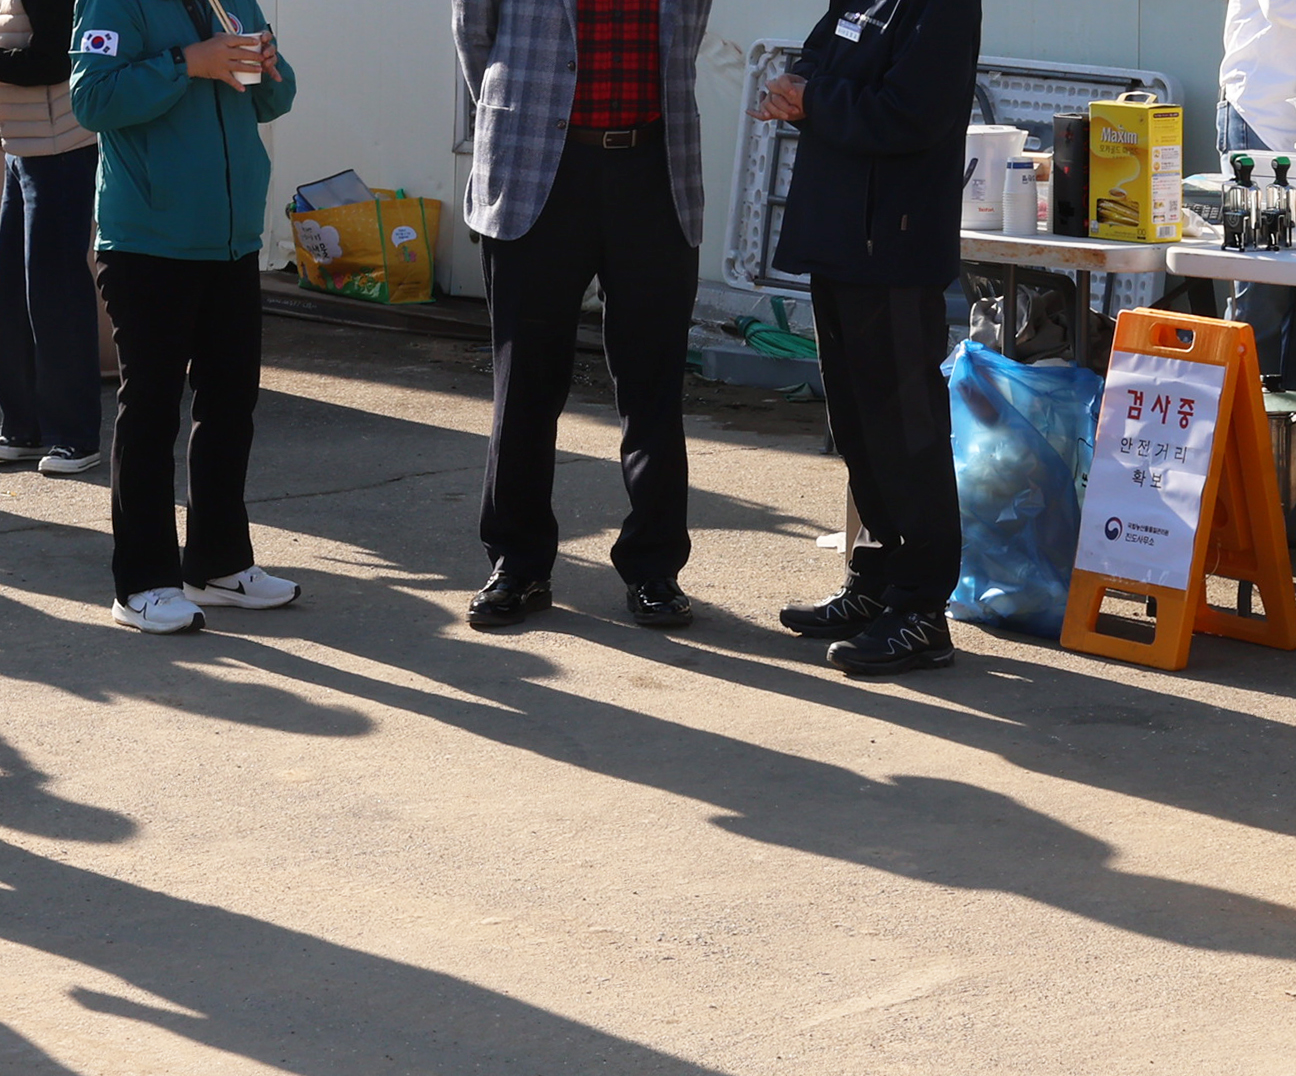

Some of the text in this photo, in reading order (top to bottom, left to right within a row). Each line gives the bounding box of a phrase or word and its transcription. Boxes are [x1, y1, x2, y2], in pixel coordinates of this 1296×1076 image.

[1100, 127, 1138, 144] Maxim
[1127, 389, 1195, 429] 검사중
[1120, 437, 1188, 464] 안전거리
[1131, 469, 1163, 489] 확보
